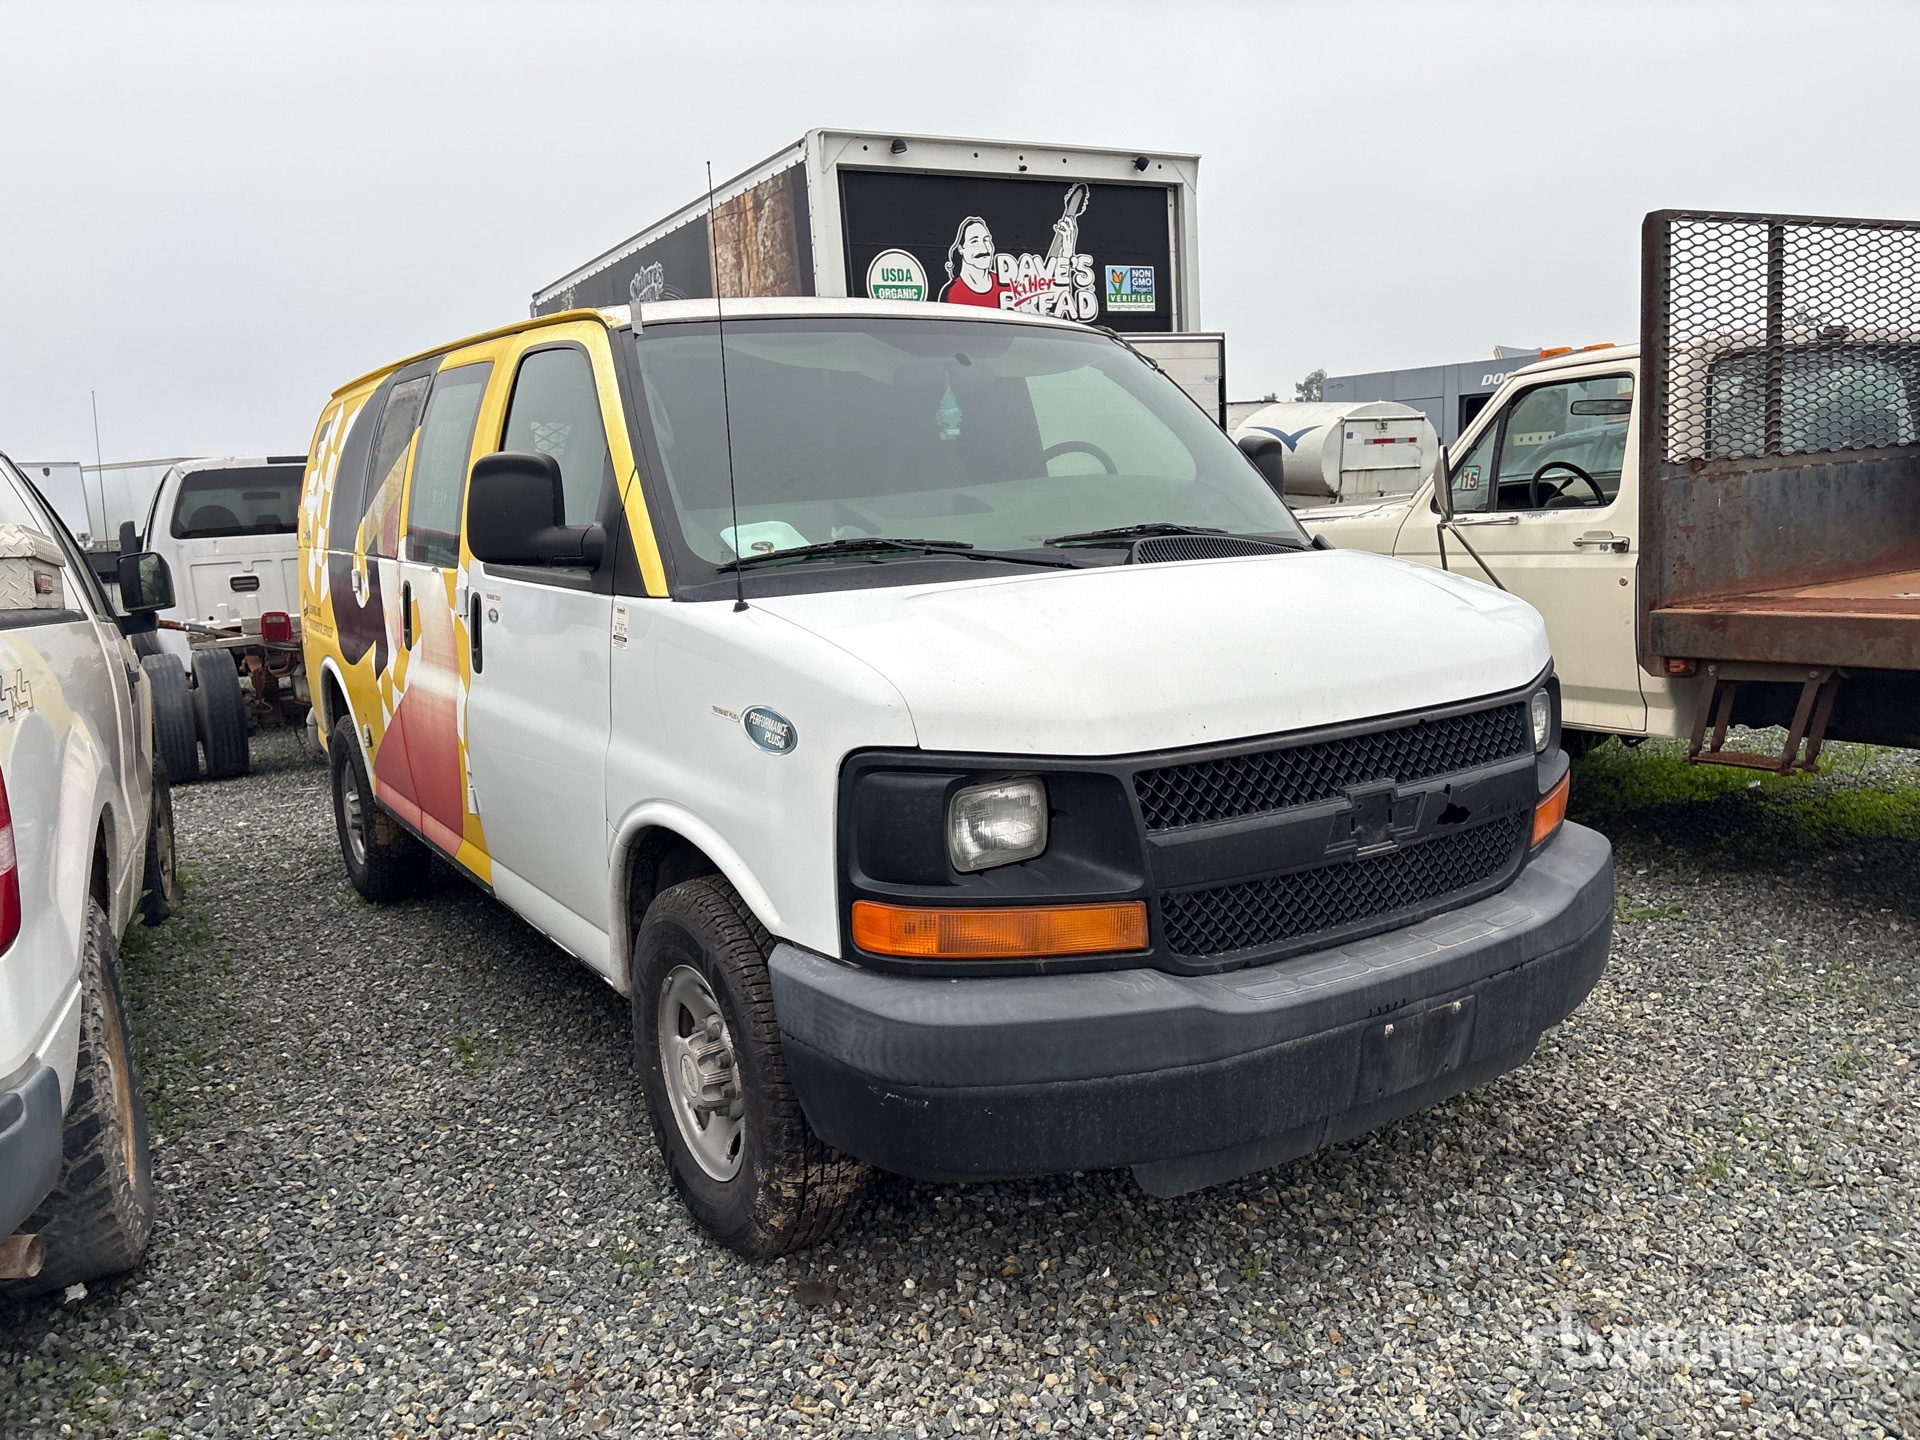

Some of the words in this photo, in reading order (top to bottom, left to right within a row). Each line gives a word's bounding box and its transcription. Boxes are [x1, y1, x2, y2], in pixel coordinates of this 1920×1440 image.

[881, 268, 913, 282] USDA
[996, 253, 1095, 287] DAVE'S
[1132, 269, 1151, 278] NON
[1132, 277, 1152, 286] GMO
[878, 288, 919, 300] ORGANIC
[1132, 286, 1152, 294] Project
[999, 289, 1099, 321] BREAD
[1110, 294, 1153, 303] VERIFIED
[1464, 472, 1478, 489] 15
[748, 711, 788, 737] PERFORMANCE
